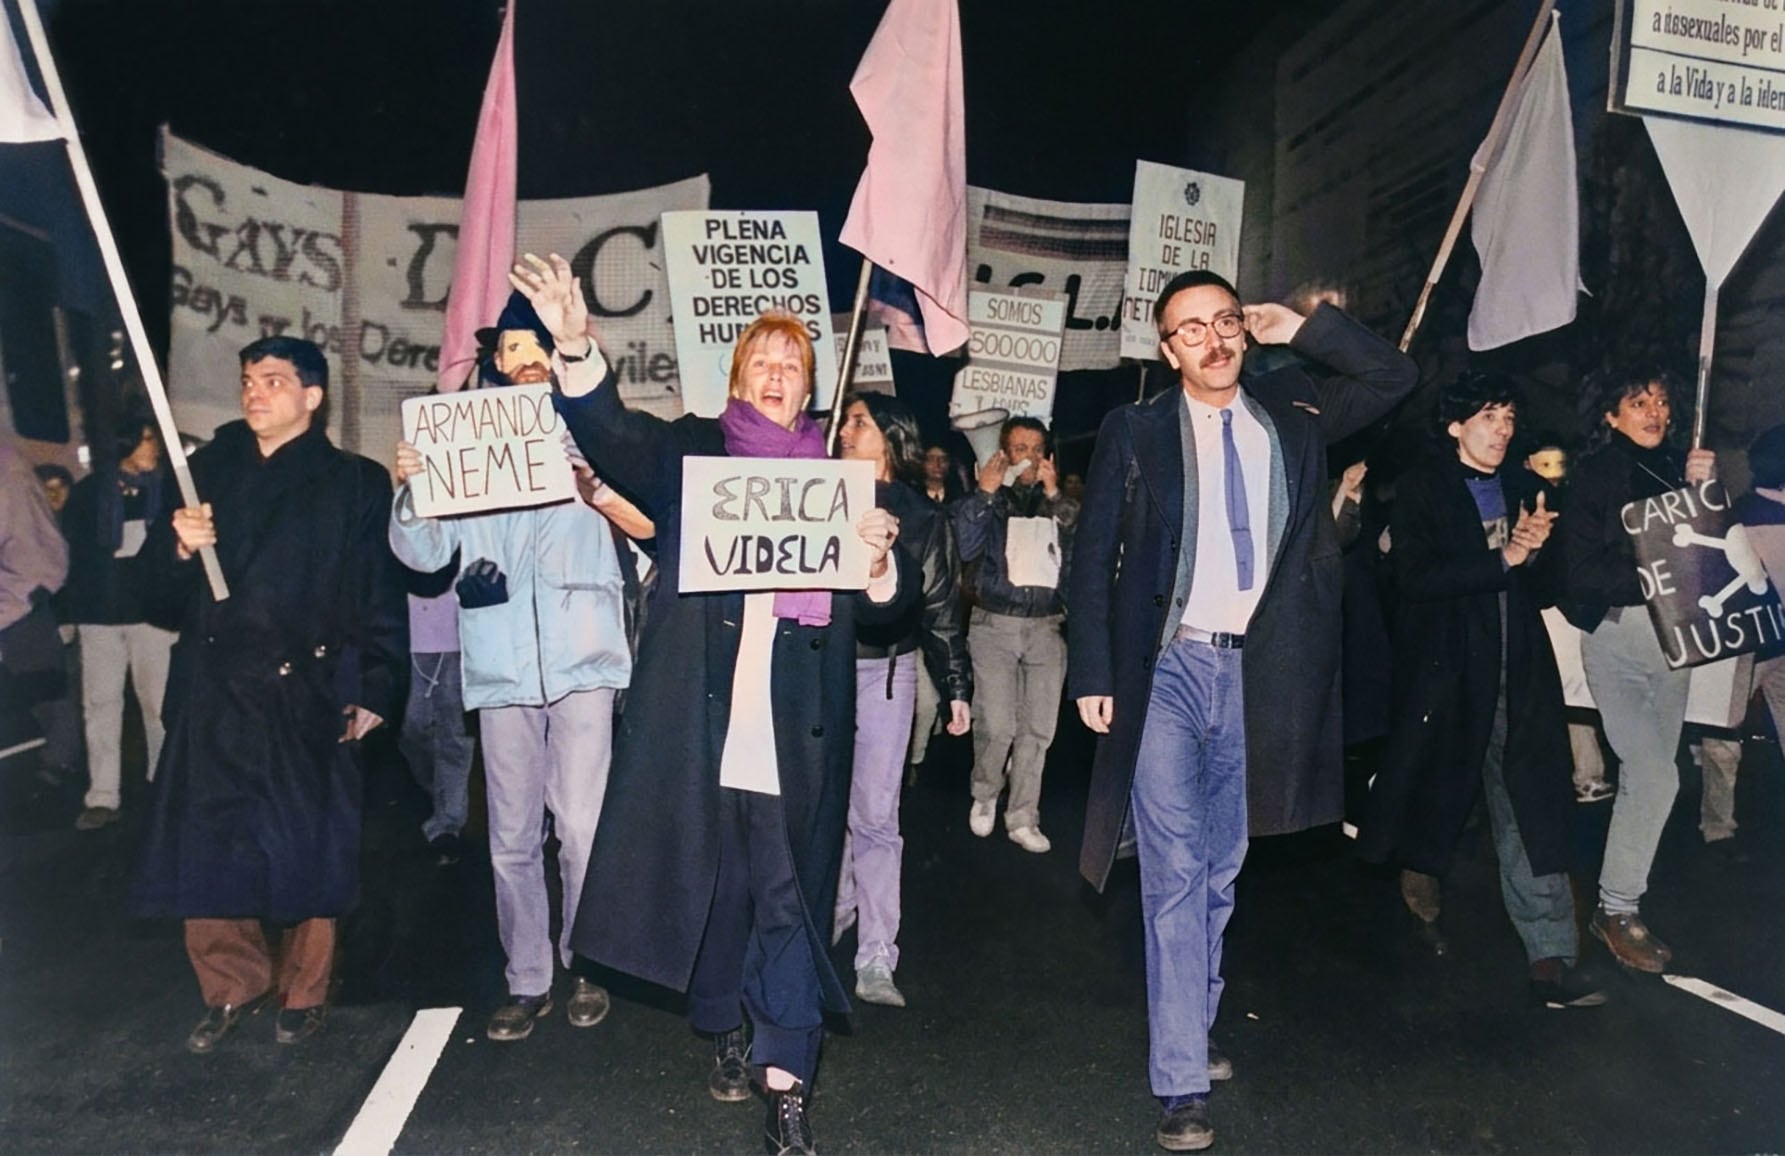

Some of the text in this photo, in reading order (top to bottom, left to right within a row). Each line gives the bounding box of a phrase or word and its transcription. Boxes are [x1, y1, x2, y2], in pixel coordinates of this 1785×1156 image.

[1652, 11, 1661, 32] a
[1742, 28, 1767, 56] por
[1770, 23, 1783, 53] el
[1656, 71, 1665, 93] a
[1669, 64, 1682, 95] la
[1686, 66, 1713, 100] Vida
[1714, 81, 1725, 109] y
[1727, 83, 1736, 103] a
[1740, 76, 1752, 106] la
[174, 174, 343, 293] GAYS
[705, 219, 787, 240] PLENA
[1159, 213, 1217, 247] IGLESIA
[692, 244, 811, 265] VIGENCIA
[1162, 244, 1210, 271] DE LA
[711, 268, 798, 289] DE LOS
[171, 264, 248, 332] Gays
[358, 319, 441, 373] Dere
[692, 294, 821, 317] DERECHOS
[987, 297, 1043, 325] SOMOS
[972, 331, 1057, 363] 500000
[962, 369, 1047, 400] LESBIANAS
[413, 391, 557, 446] ARMANDO
[425, 438, 547, 503] NEME
[712, 475, 849, 522] ERICA
[704, 534, 841, 576] VIDELA
[1637, 559, 1676, 600] DE
